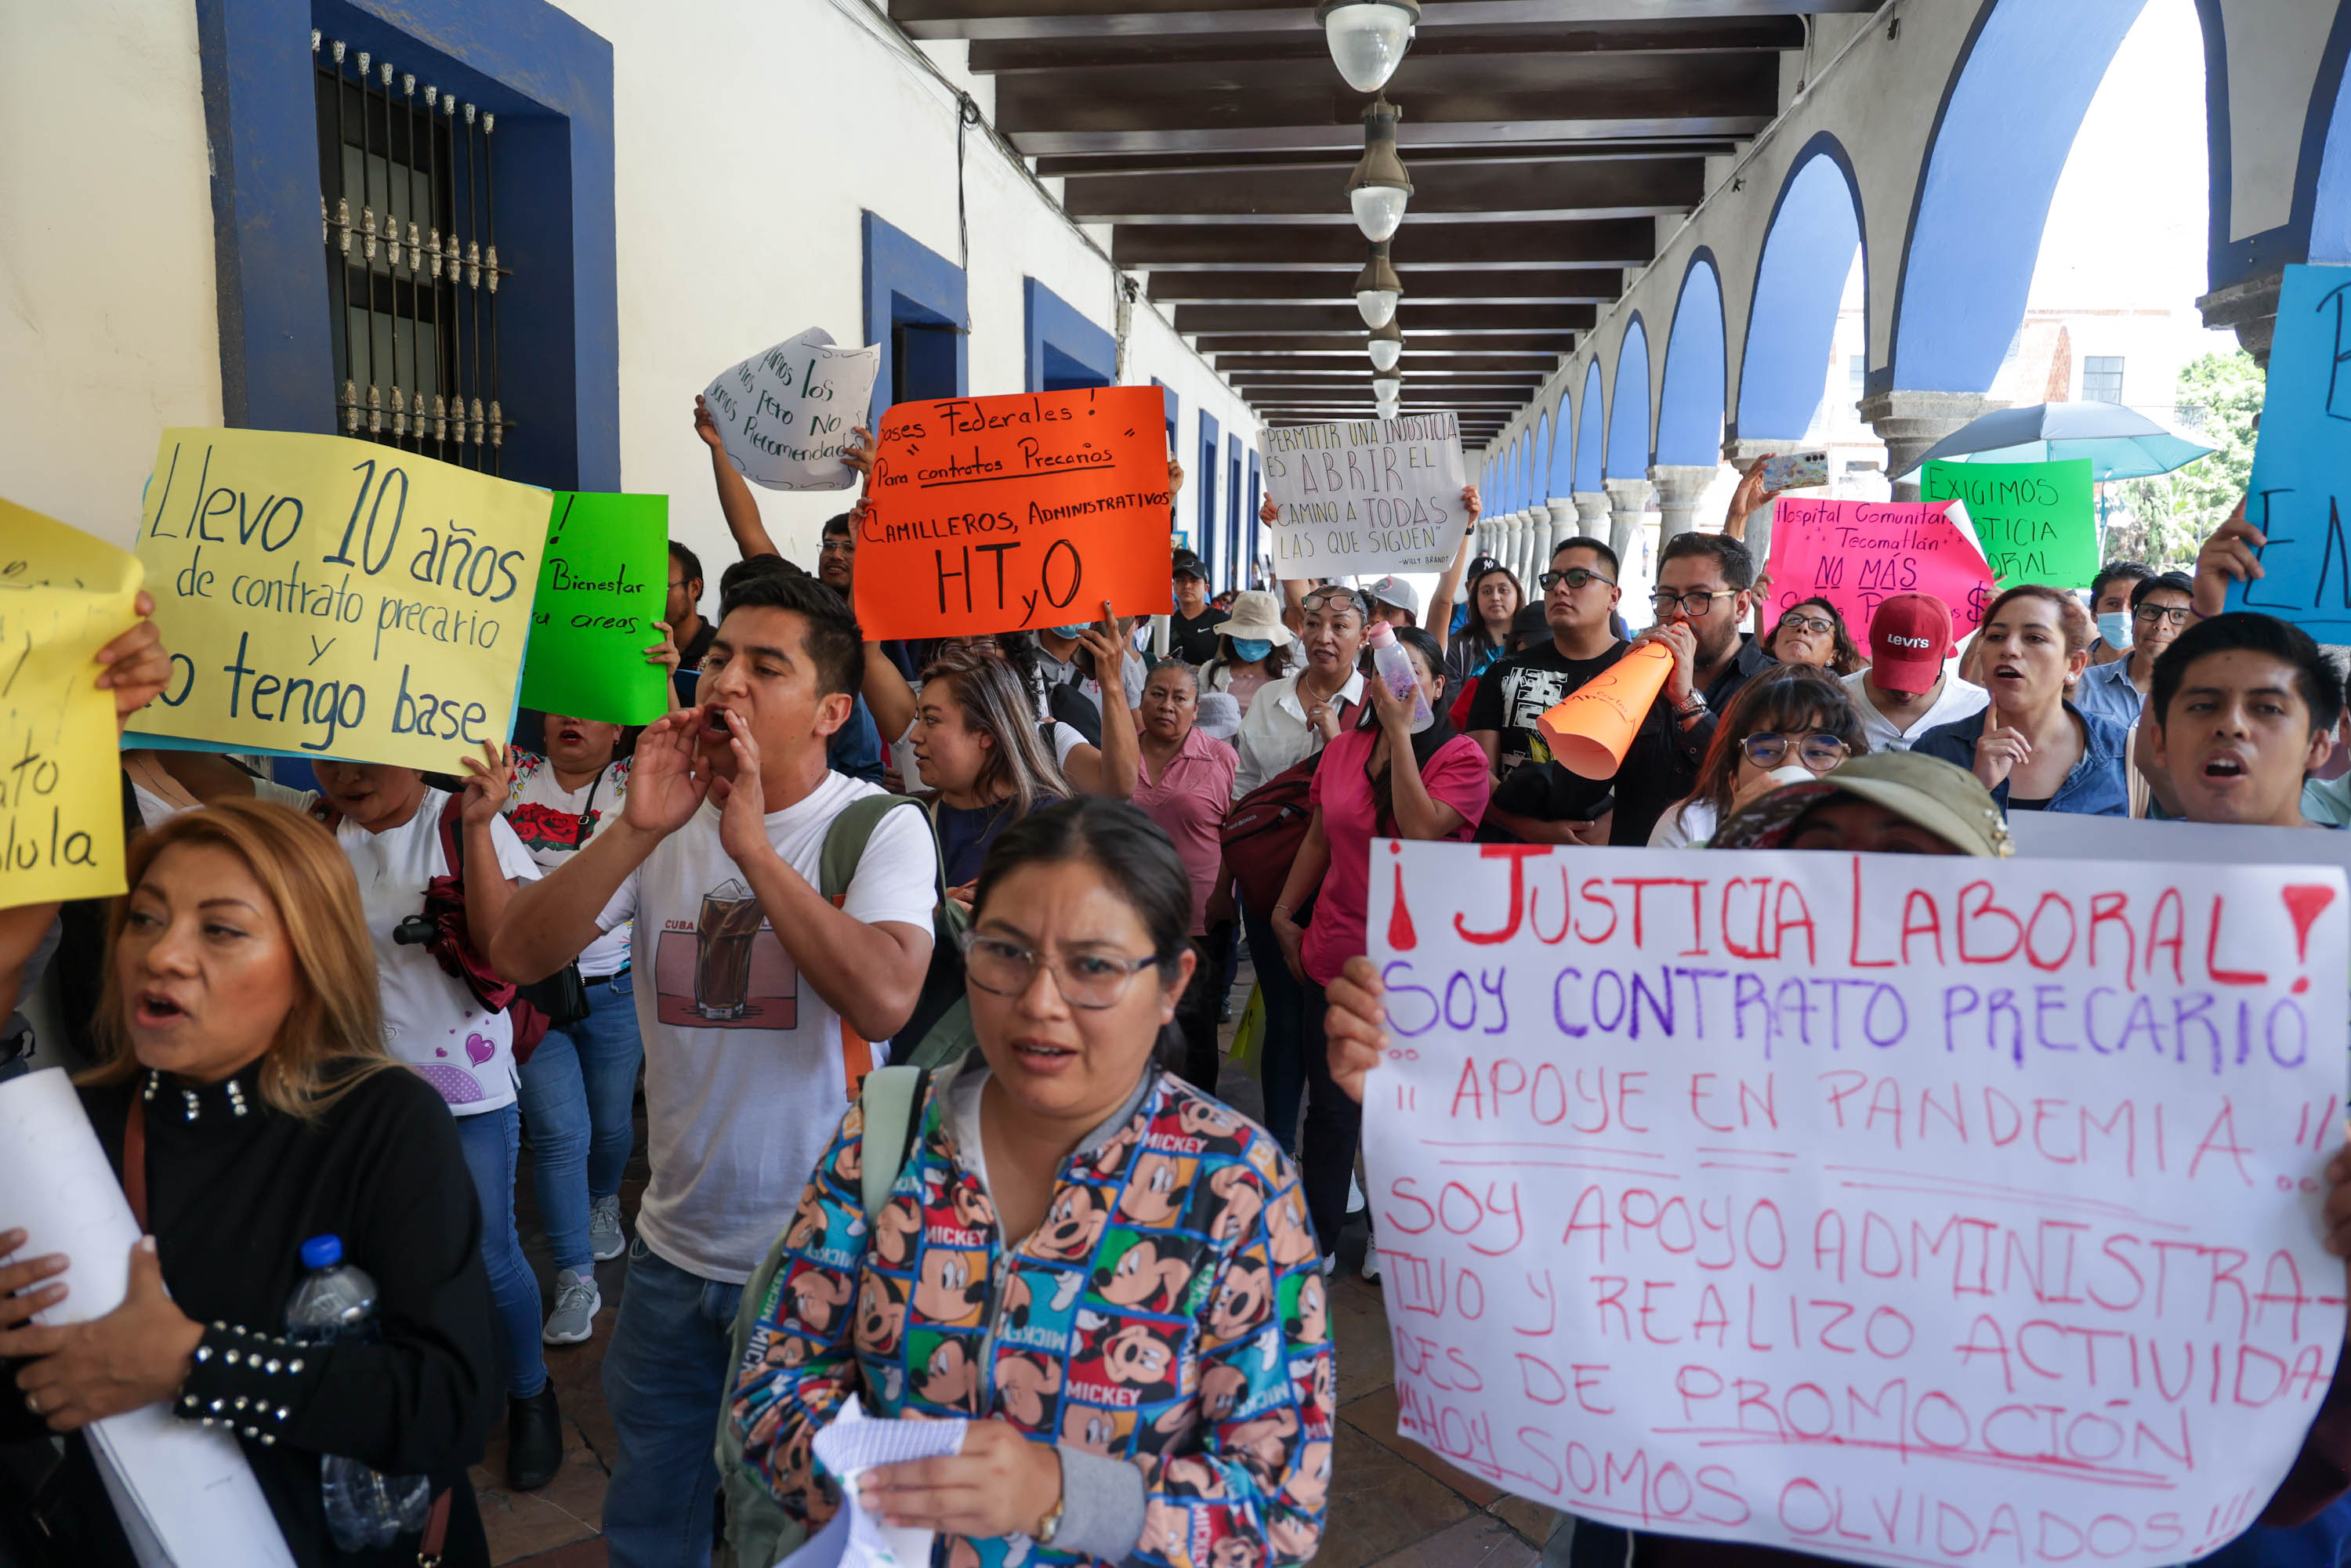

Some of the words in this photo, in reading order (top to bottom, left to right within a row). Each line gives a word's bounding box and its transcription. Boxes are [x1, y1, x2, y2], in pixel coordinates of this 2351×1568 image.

[800, 359, 833, 401] los
[1348, 421, 1378, 447] UNA
[1384, 413, 1458, 444] INJUSTICIA
[1266, 455, 1287, 477] ES
[1302, 446, 1404, 496] ABRIR
[1408, 447, 1436, 469] EL
[1929, 466, 2059, 506] EXIGIMOS
[150, 442, 304, 552] Llevo
[322, 458, 409, 576] 10
[408, 518, 526, 603] años
[1276, 500, 1339, 527] CAMINO
[1346, 500, 1357, 523] A
[1362, 495, 1448, 529] TODAS
[1776, 501, 1842, 527] Hospital
[1280, 532, 1314, 559] LAS
[1327, 531, 1360, 555] QUE
[1835, 527, 1940, 552] Tecomatlán
[1814, 555, 1844, 587] NO
[176, 545, 215, 598] de
[230, 559, 365, 625] contrato
[376, 595, 501, 661] precario
[223, 631, 366, 751] tengo
[391, 664, 487, 745] base
[665, 919, 695, 931] CUBA
[1381, 959, 1508, 1038] SOY
[1553, 963, 1909, 1061] CONTRATO
[1942, 983, 2308, 1077] PRECARIO
[1689, 1073, 1779, 1133] EN
[1143, 1131, 1210, 1154] MICKEY
[923, 1225, 990, 1248] MICKEY
[1385, 1177, 1523, 1257] SOY
[1562, 1185, 1788, 1270] APOYO
[1590, 1276, 1914, 1360] REALIZO
[1065, 1378, 1143, 1407] MICKEY
[1514, 1352, 1615, 1414] DE
[1517, 1426, 1751, 1526] SOMOS
